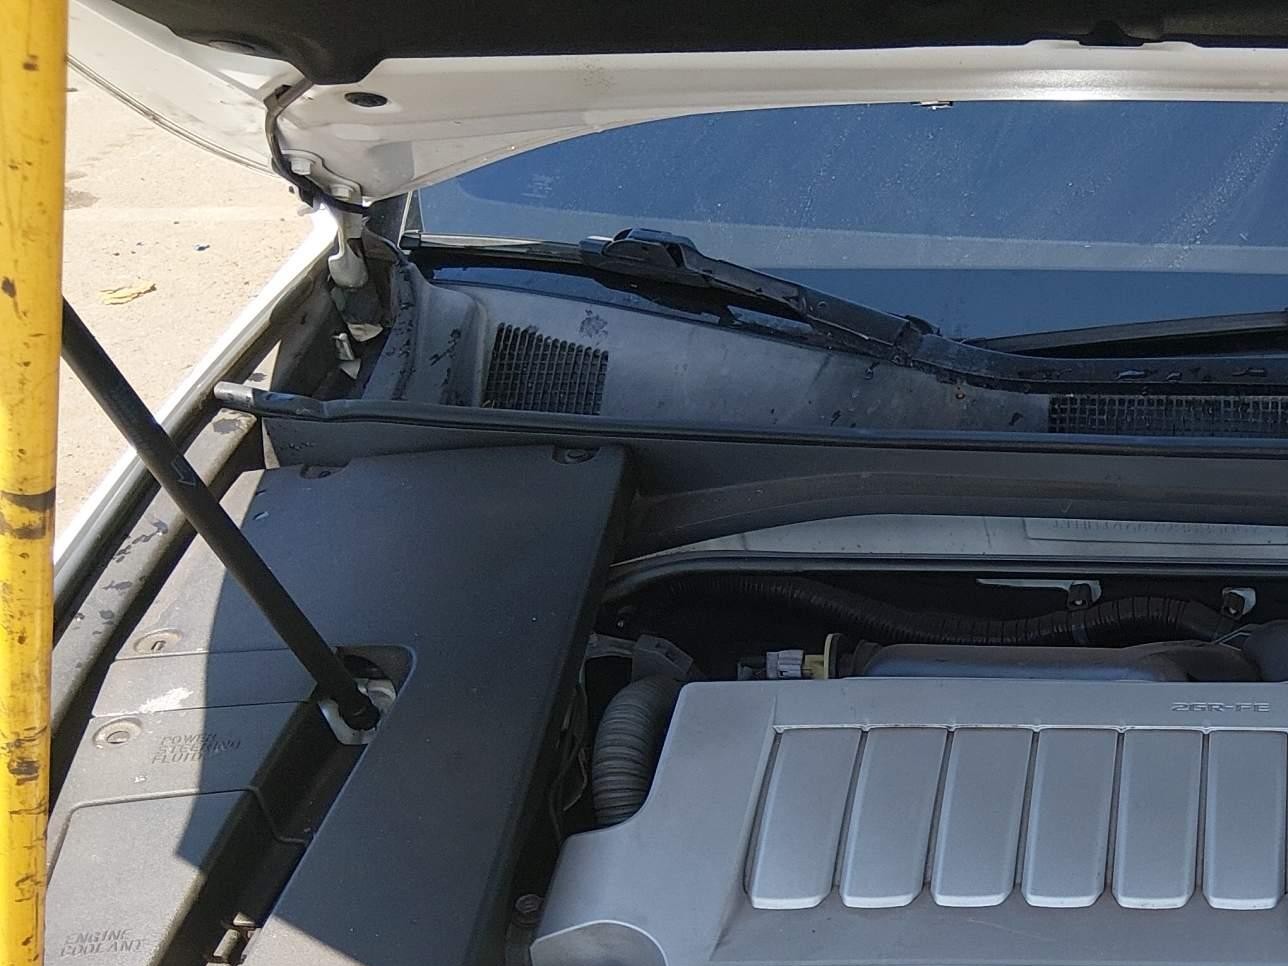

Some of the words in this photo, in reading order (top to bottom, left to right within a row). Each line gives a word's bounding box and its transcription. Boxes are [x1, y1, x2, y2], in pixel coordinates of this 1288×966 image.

[1171, 701, 1273, 713] 2GR-FE
[158, 737, 242, 754] STEERING
[160, 733, 217, 746] POWER
[64, 928, 134, 944] ENGINE
[60, 939, 147, 957] COOLANT
